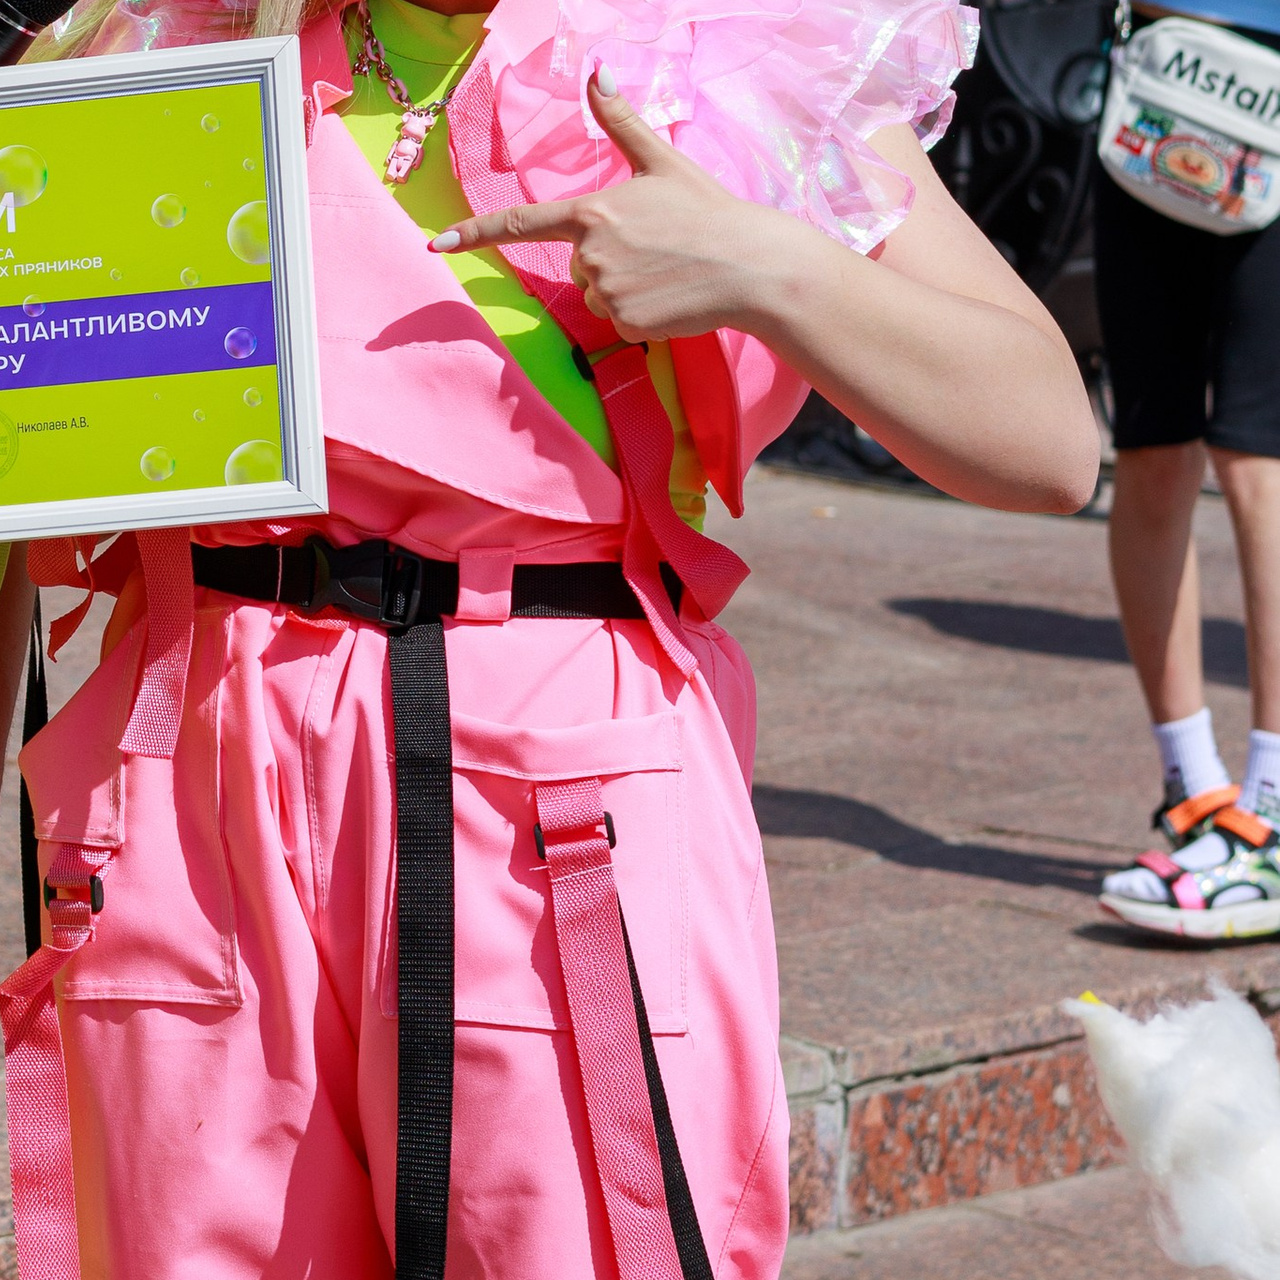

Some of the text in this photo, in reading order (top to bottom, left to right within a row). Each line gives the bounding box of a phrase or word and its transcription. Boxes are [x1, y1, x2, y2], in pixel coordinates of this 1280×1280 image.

[14, 256, 103, 276] ПРЯНИКОВ
[17, 416, 90, 434] Николаев А.В.
